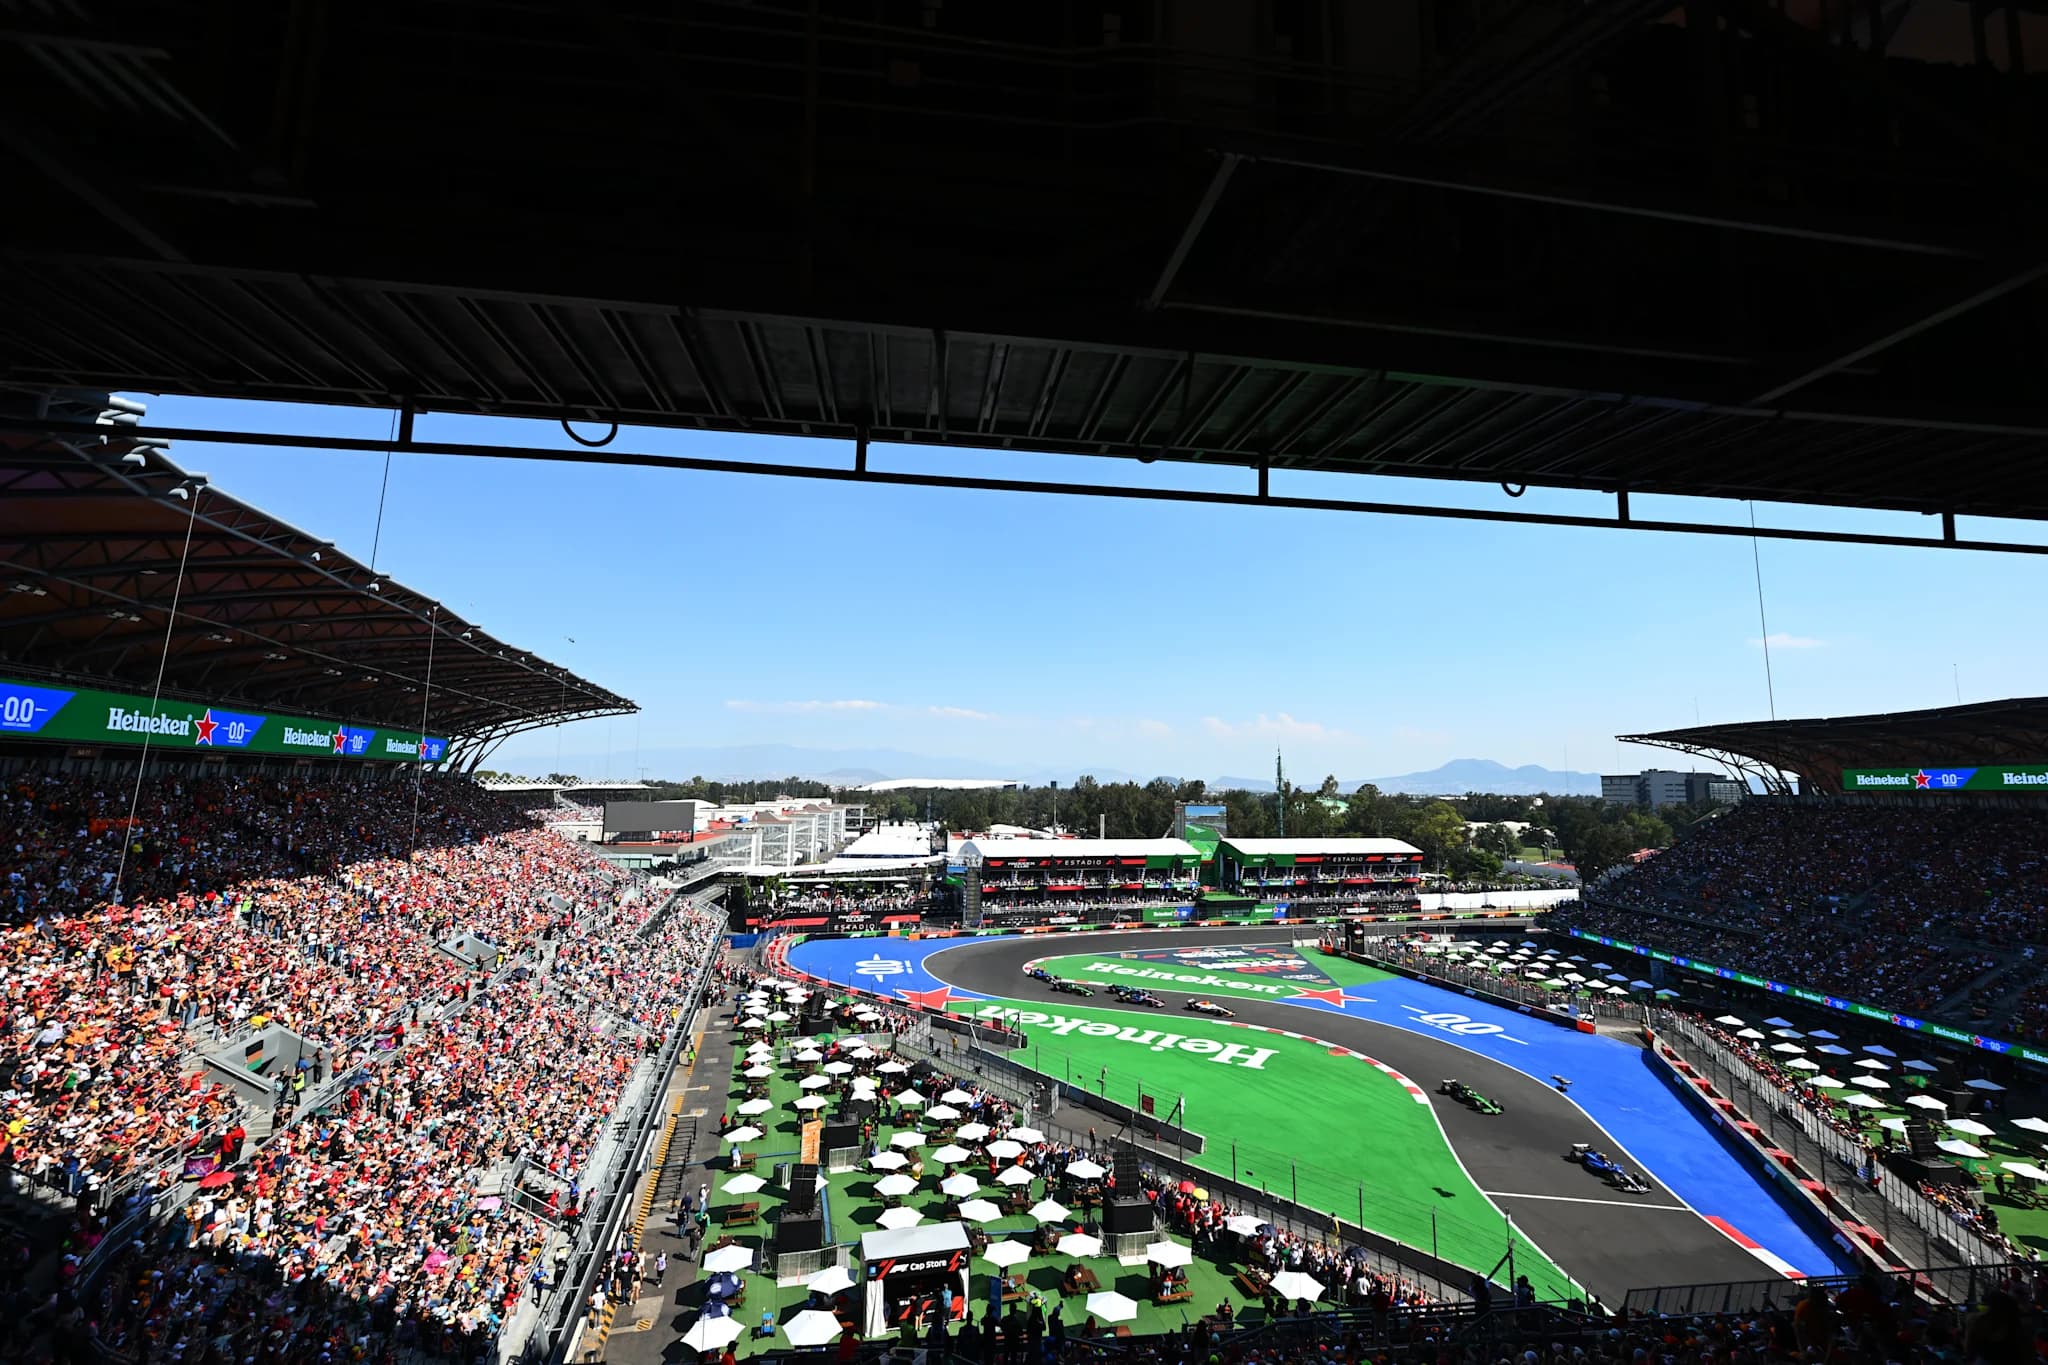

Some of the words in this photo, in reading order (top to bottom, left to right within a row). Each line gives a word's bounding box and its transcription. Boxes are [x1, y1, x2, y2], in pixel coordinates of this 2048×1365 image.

[3, 696, 35, 723] 0.0
[106, 707, 190, 737] Heineken
[283, 727, 331, 748] Heineken
[386, 738, 417, 754] Heineken
[1856, 774, 1910, 786] Heineken
[1064, 859, 1102, 867] ESTADIO
[1083, 962, 1285, 994] Heineken
[980, 1005, 1280, 1069] Heineken
[910, 1262, 925, 1271] Cap
[926, 1260, 947, 1269] Store
